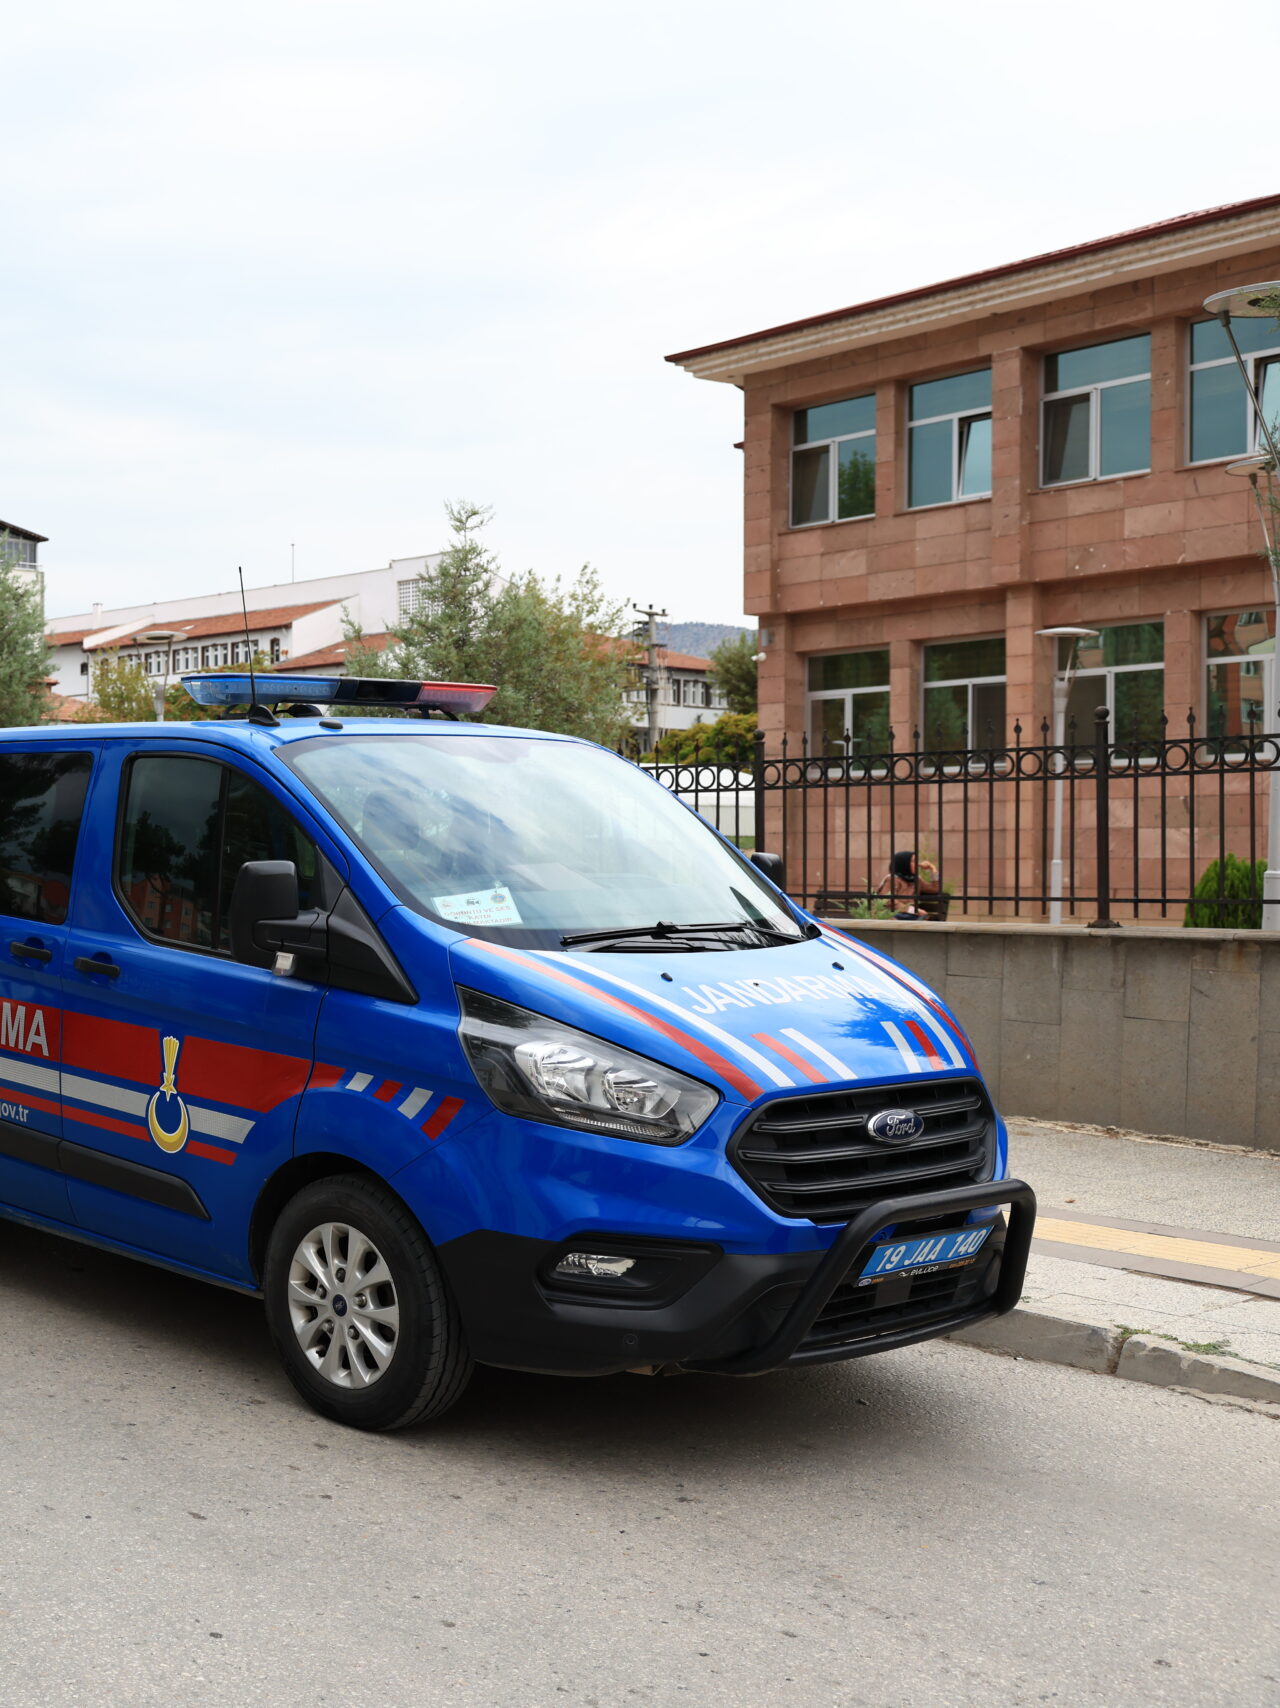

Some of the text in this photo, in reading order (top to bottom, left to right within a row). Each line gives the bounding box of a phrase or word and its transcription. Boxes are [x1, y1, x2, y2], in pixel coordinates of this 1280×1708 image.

[681, 975, 892, 1014] JANDARMA
[886, 1114, 916, 1137] Ford
[875, 1229, 987, 1273] 19 JAA 140
